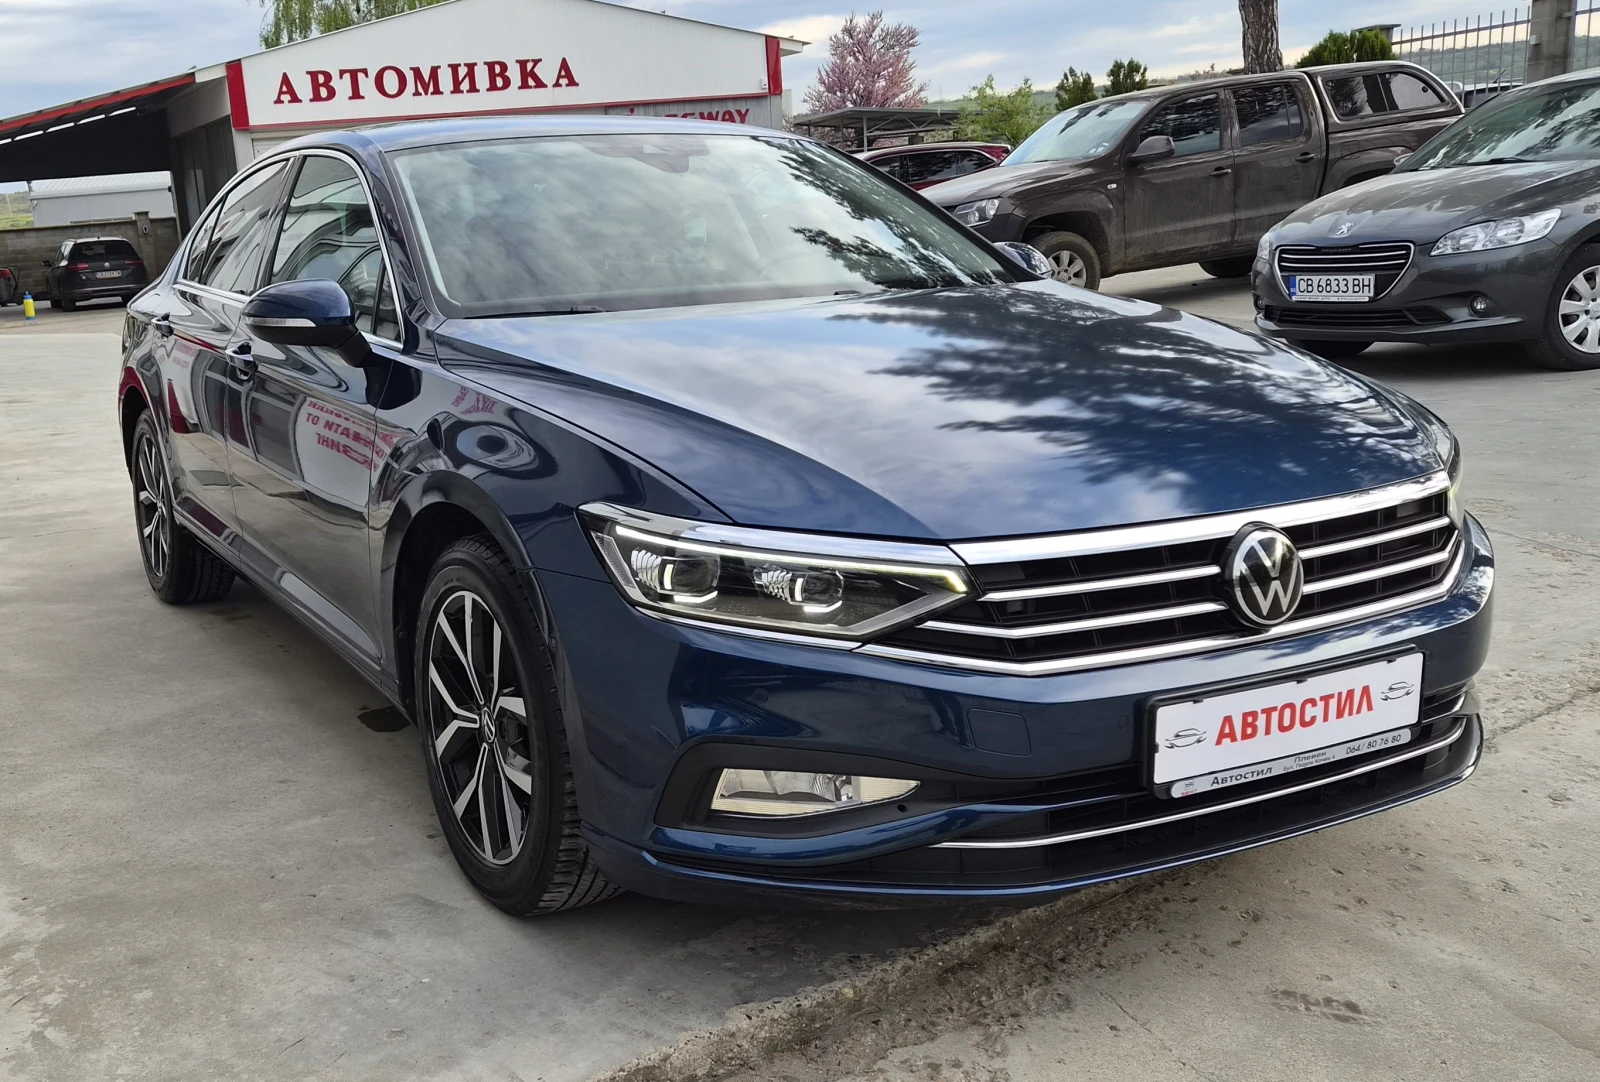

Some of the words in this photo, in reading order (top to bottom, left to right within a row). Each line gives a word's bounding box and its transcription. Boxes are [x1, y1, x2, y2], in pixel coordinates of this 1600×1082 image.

[273, 57, 579, 104] АВТОМИВКА
[1297, 278, 1314, 293] CB
[1317, 278, 1349, 293] 6833
[1352, 277, 1371, 293] BH
[1215, 685, 1374, 746] АВТОСТИЛ
[1366, 739, 1378, 749] 80
[1379, 737, 1390, 746] 76
[1391, 734, 1402, 743] 80
[1294, 752, 1327, 763] Плевен
[1210, 767, 1273, 787] Автостил
